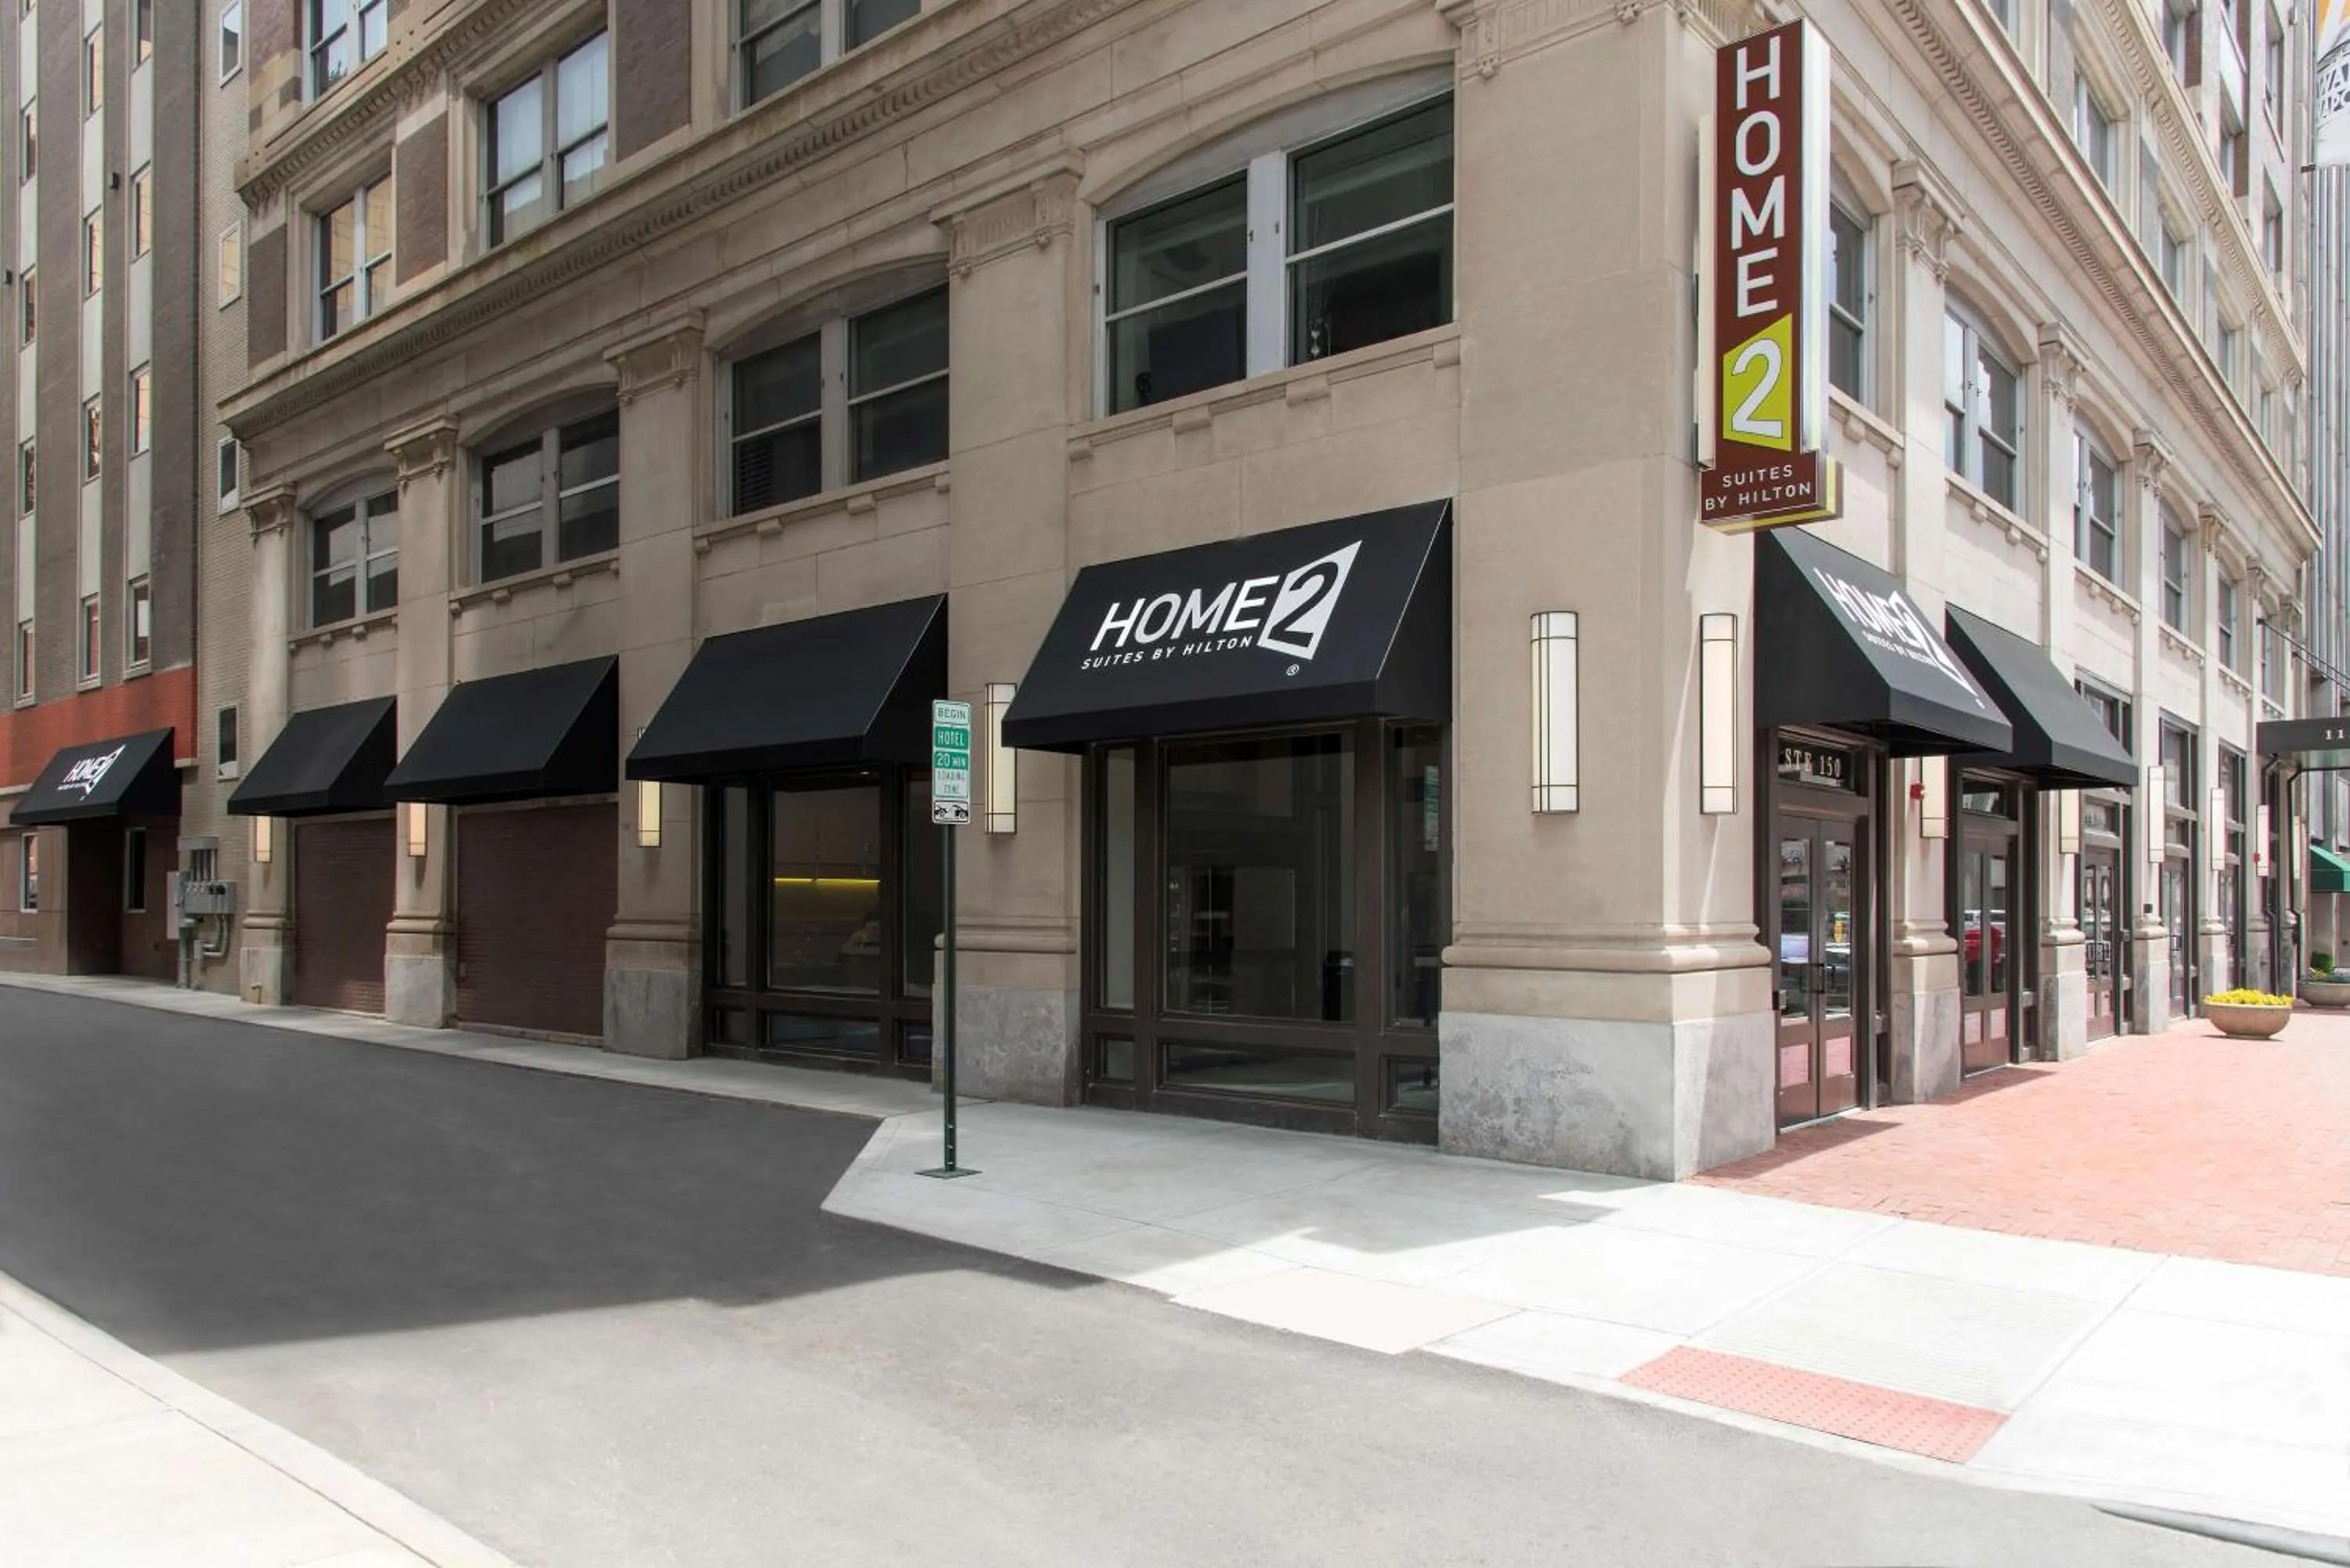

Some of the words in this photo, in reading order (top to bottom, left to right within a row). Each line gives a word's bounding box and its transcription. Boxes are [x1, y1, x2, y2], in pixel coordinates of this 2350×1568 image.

[1723, 464, 1793, 488] SUITES
[1705, 496, 1728, 511] BY
[1738, 482, 1811, 505] HILTON
[1081, 651, 1144, 670] SUITES
[1152, 646, 1175, 661] BY
[1183, 635, 1253, 656] HILTON
[938, 707, 966, 719] BEGIN
[938, 731, 965, 746] HOTEL
[938, 753, 950, 767] 20
[1820, 754, 1841, 778] 150
